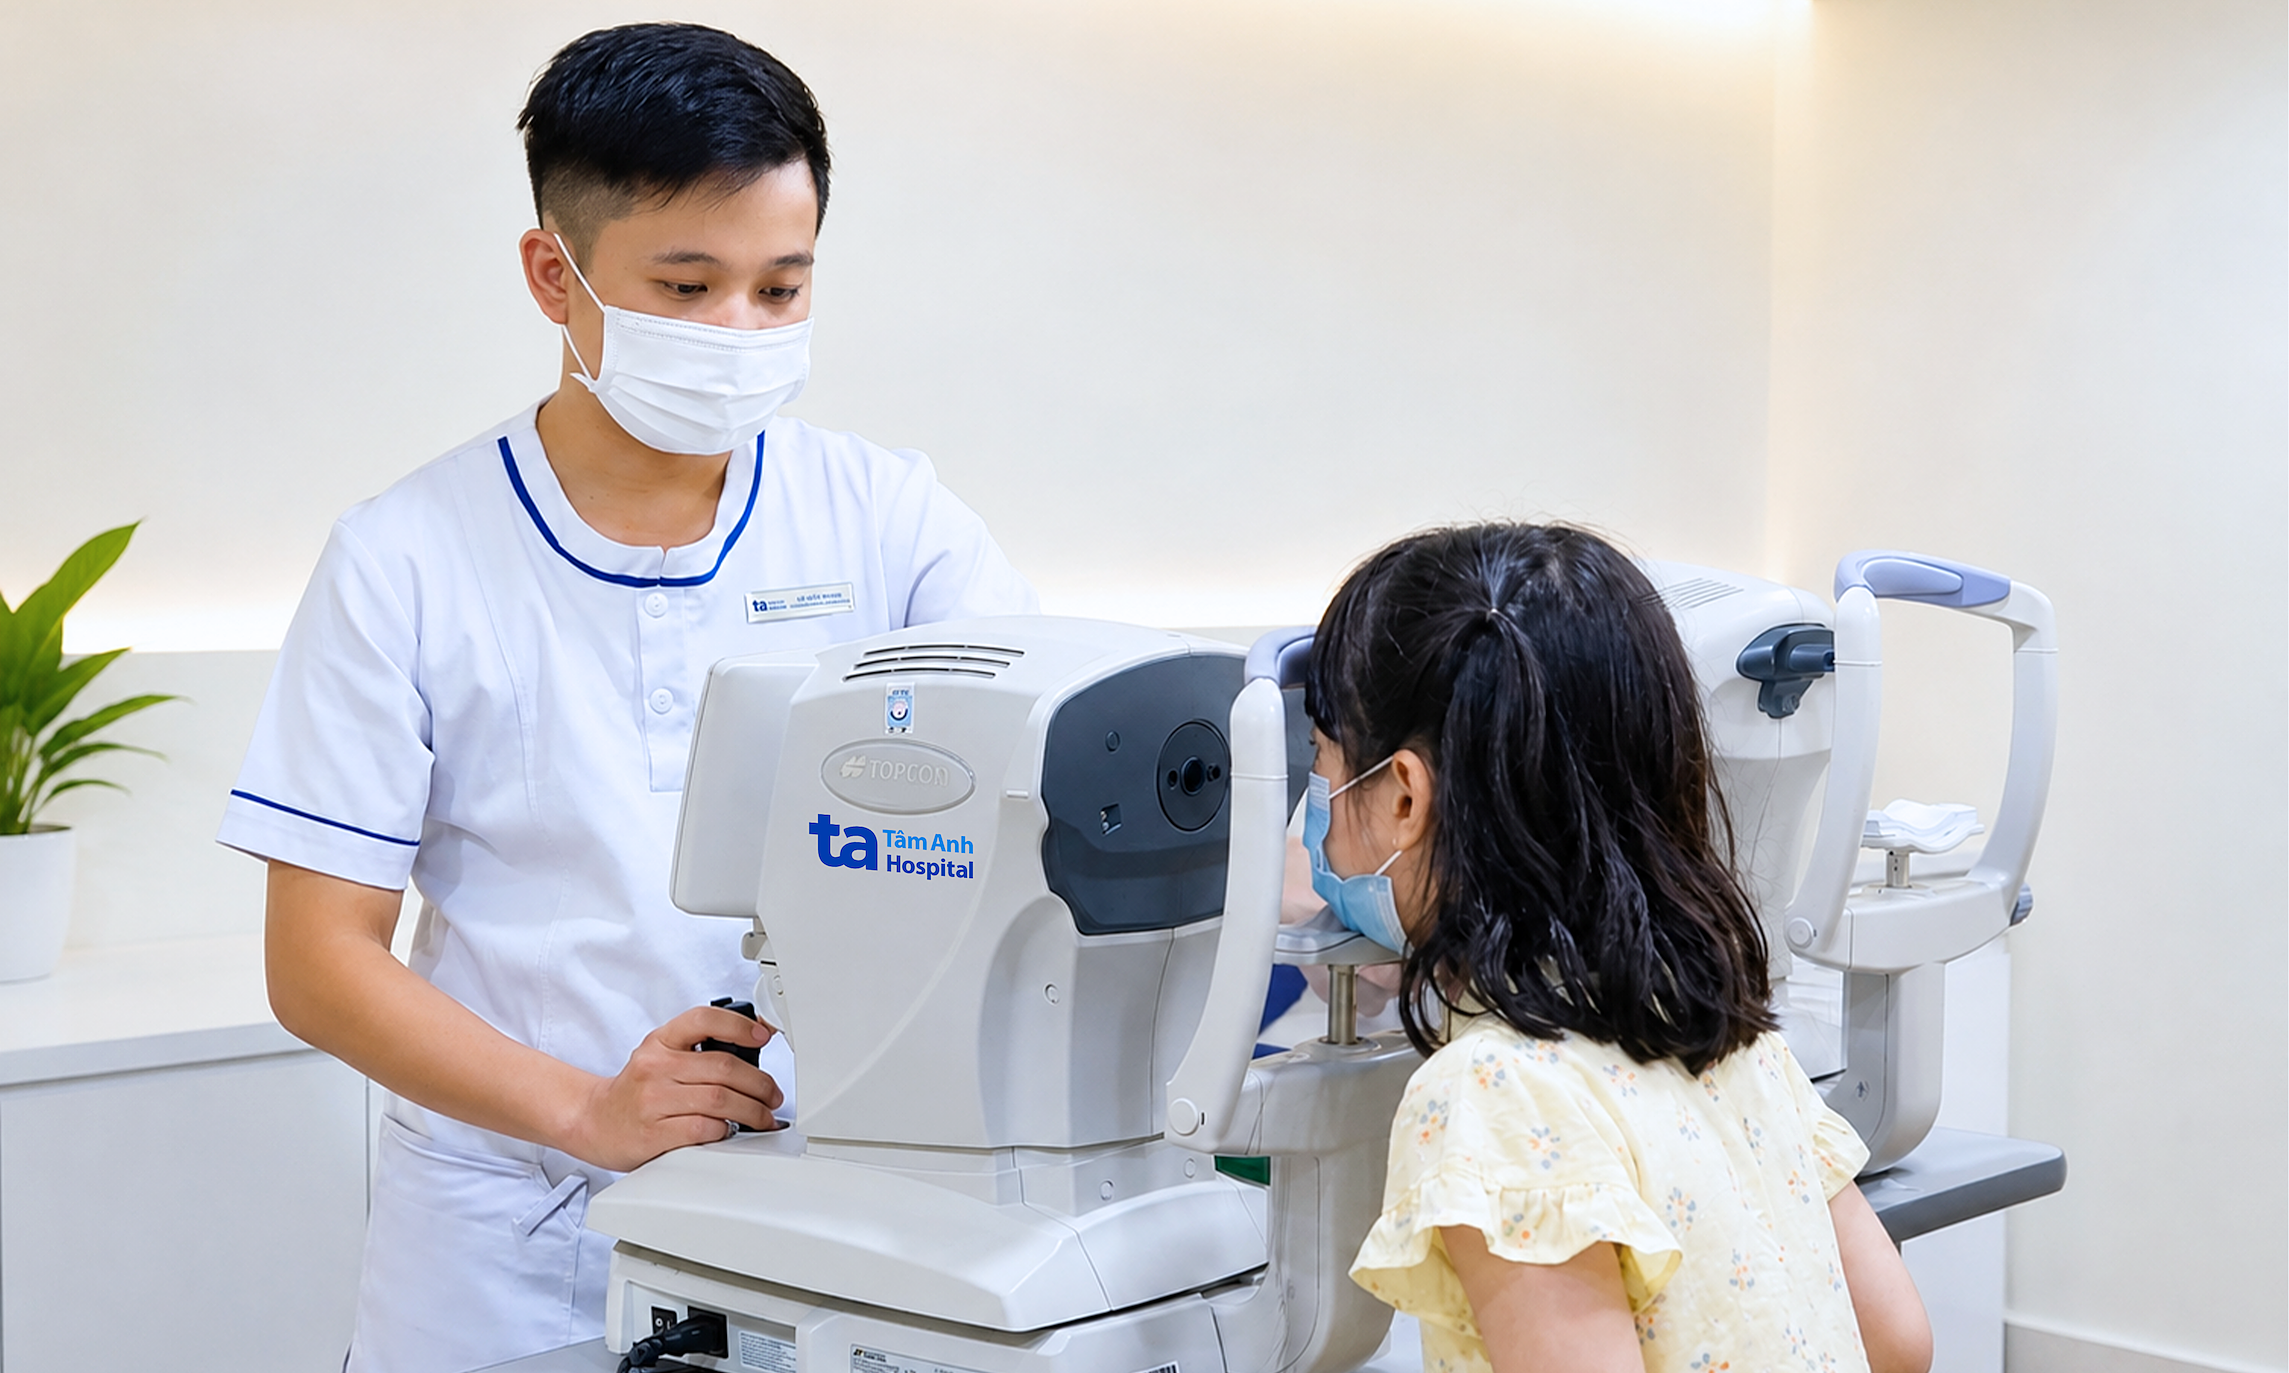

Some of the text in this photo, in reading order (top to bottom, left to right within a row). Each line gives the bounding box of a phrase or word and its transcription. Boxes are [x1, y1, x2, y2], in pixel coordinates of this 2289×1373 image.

[752, 599, 768, 612] ta
[869, 759, 951, 786] TOPCON
[808, 813, 878, 871] ta
[882, 828, 974, 855] Tâm Anh
[886, 854, 974, 881] Hospital
